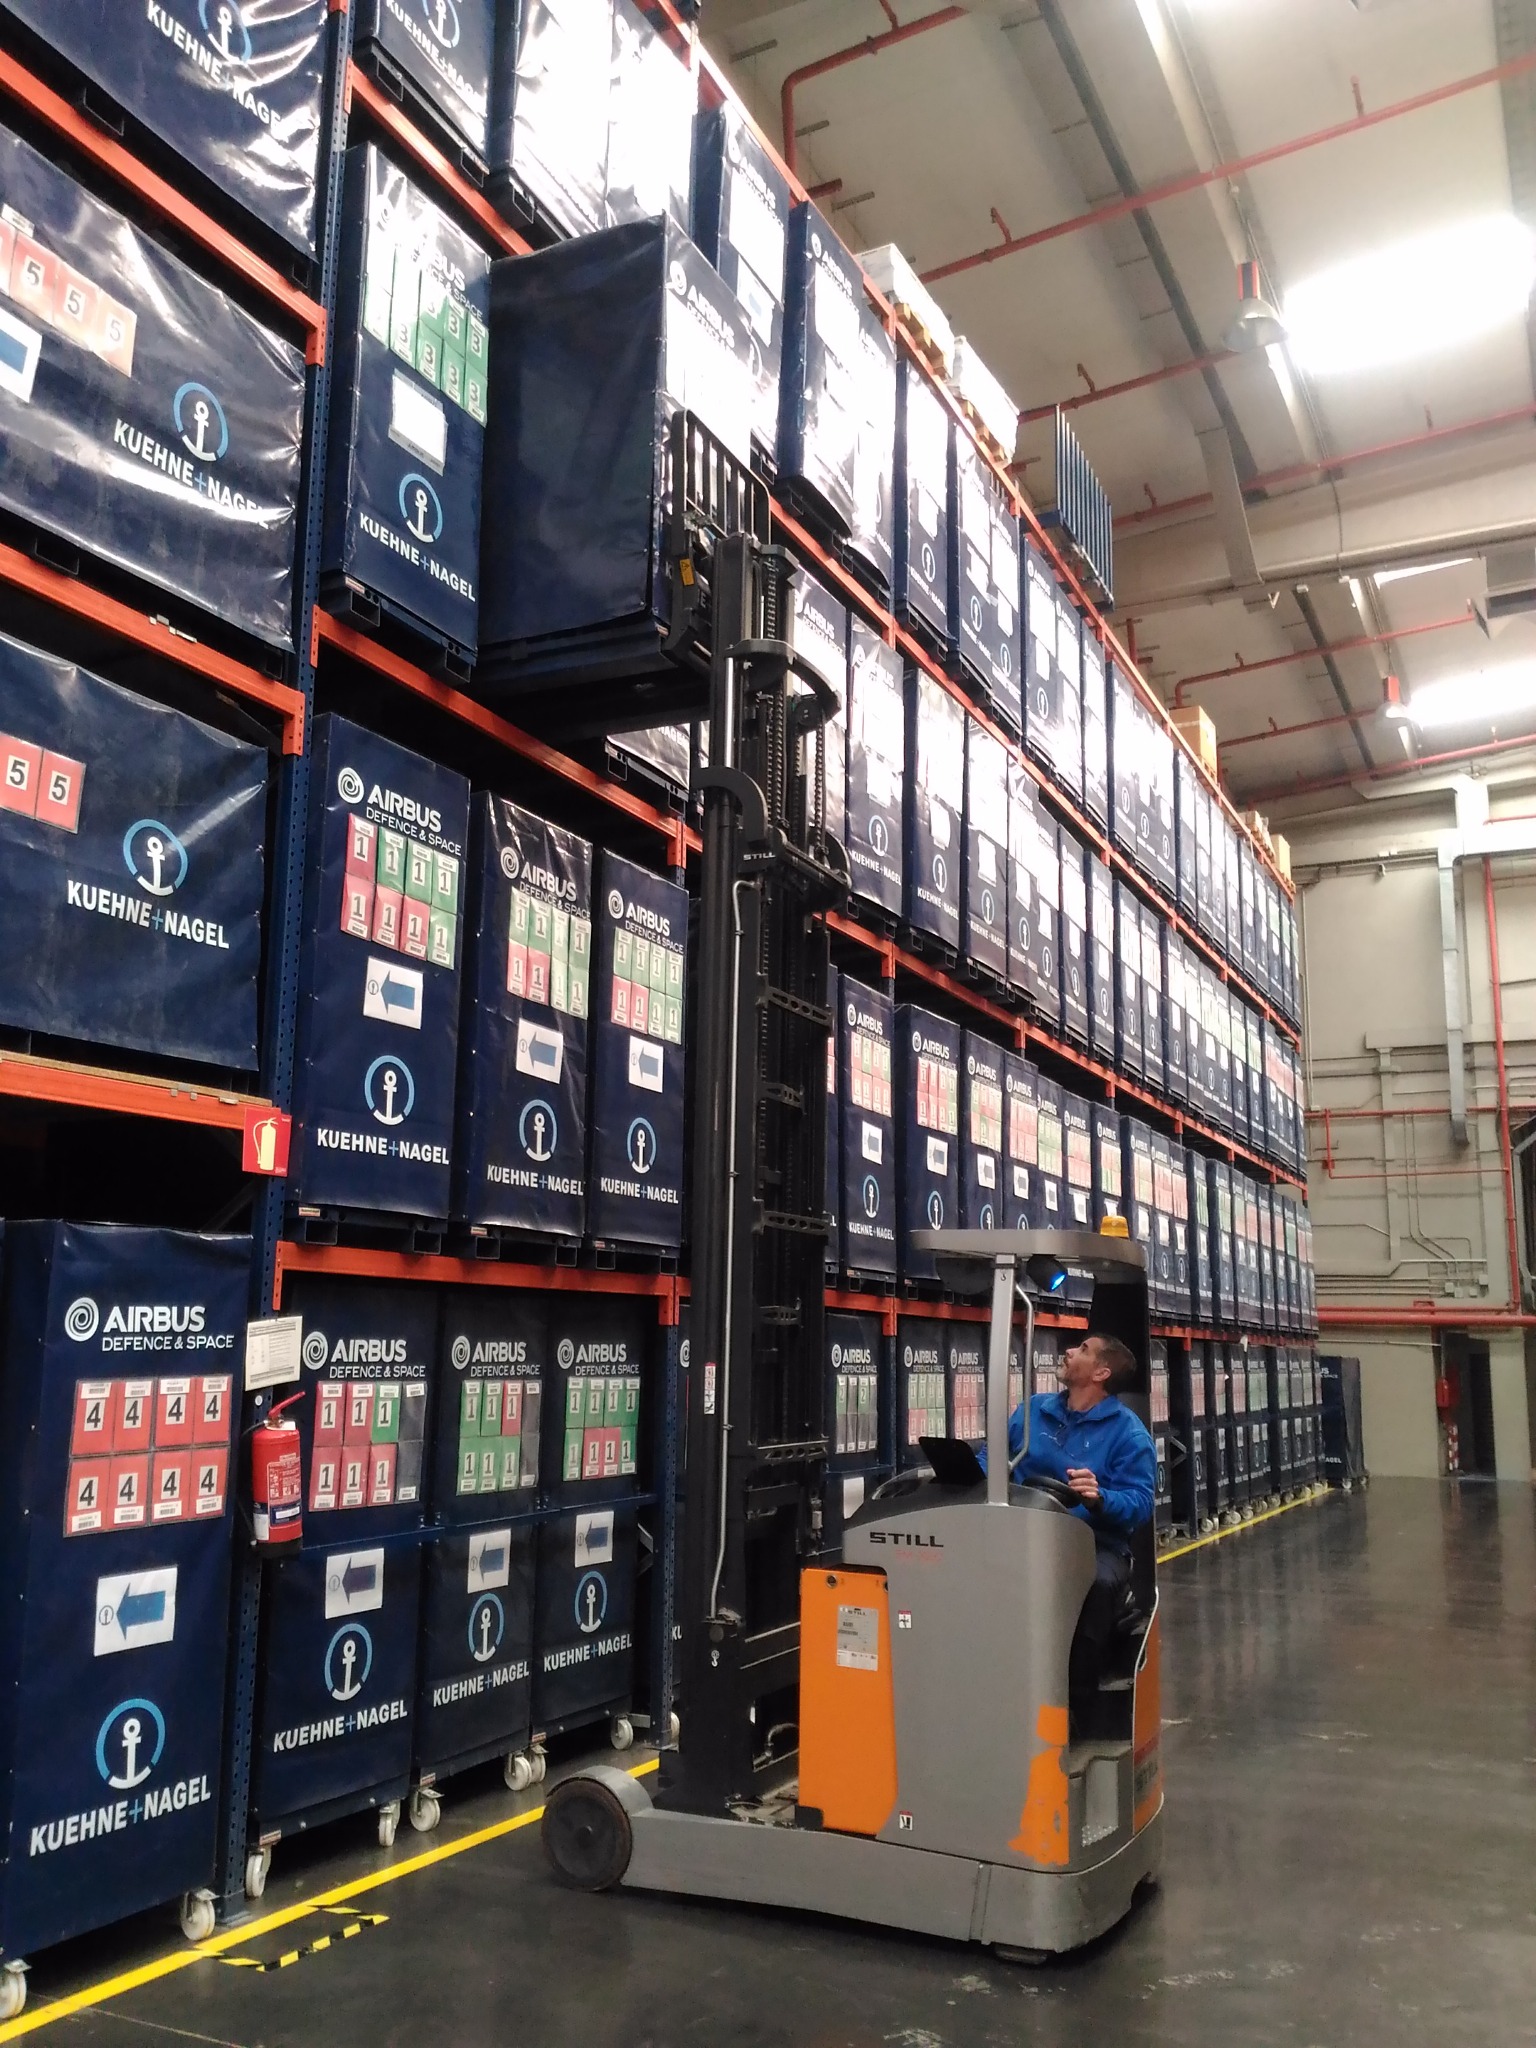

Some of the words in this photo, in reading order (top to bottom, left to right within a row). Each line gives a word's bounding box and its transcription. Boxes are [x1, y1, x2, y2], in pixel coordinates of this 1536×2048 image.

[26, 260, 42, 286] 5
[67, 289, 82, 315] 5
[110, 319, 122, 342] 5
[449, 315, 459, 336] 3
[472, 333, 481, 354] 3
[400, 323, 409, 345] 3
[424, 343, 434, 365] 3
[449, 364, 459, 385] 3
[469, 382, 480, 403] 3
[360, 511, 476, 603] KUEHNE+NAGEL
[9, 759, 27, 787] 5
[52, 775, 69, 802] 5
[367, 784, 442, 833] AIRBUS
[366, 806, 418, 840] DEFENCE
[418, 830, 427, 842] &
[428, 833, 462, 857] SPACE
[356, 836, 366, 859] 1
[387, 850, 396, 872] 1
[413, 861, 423, 884] 1
[439, 871, 449, 893] 1
[521, 861, 577, 902] AIRBUS
[67, 879, 230, 949] KUEHNE+NAGEL
[520, 881, 557, 909] DEFENCE
[565, 902, 591, 923] SPACE
[353, 896, 363, 918] 1
[383, 906, 393, 928] 1
[408, 916, 419, 938] 1
[436, 928, 446, 950] 1
[517, 909, 525, 927] 1
[537, 917, 545, 936] 1
[556, 926, 562, 944] 1
[576, 932, 583, 951] 1
[626, 902, 671, 937] AIRBUS
[625, 920, 657, 942] DEFENCE
[662, 937, 684, 955] SPACE
[857, 1012, 883, 1036] AIRBUS
[922, 1038, 950, 1060] AIRBUS
[317, 1127, 450, 1166] KUEHNE+NAGEL
[487, 1164, 584, 1198] KUEHNE+NAGEL
[600, 1177, 680, 1205] KUEHNE+NAGEL
[848, 1221, 895, 1240] KUEHNE+NAGEL
[103, 1305, 206, 1334] AIRBUS
[102, 1336, 172, 1352] DEFENCE
[174, 1335, 185, 1350] &
[186, 1334, 235, 1350] SPACE
[331, 1339, 407, 1363] AIRBUS
[472, 1342, 527, 1363] AIRBUS
[576, 1344, 627, 1363] AIRBUS
[842, 1349, 871, 1364] AIRBUS
[913, 1350, 938, 1364] AIRBUS
[329, 1366, 382, 1379] DEFENCE
[382, 1366, 392, 1378] &
[393, 1365, 426, 1378] SPACE
[471, 1365, 508, 1377] DEFENCE
[516, 1364, 541, 1375] SPACE
[575, 1365, 610, 1376] DEFENCE
[617, 1364, 640, 1375] SPACE
[86, 1401, 101, 1430] 4
[125, 1400, 140, 1426] 4
[168, 1395, 183, 1423] 4
[206, 1394, 219, 1420] 4
[323, 1402, 334, 1426] 1
[354, 1401, 364, 1425] 1
[380, 1402, 390, 1425] 1
[467, 1398, 475, 1419] 1
[487, 1397, 496, 1418] 1
[508, 1396, 516, 1418] 1
[571, 1393, 578, 1411] 1
[591, 1393, 599, 1412] 1
[610, 1392, 617, 1410] 1
[627, 1391, 634, 1410] 1
[465, 1454, 473, 1475] 1
[484, 1453, 493, 1475] 1
[505, 1452, 513, 1473] 1
[570, 1446, 577, 1466] 1
[591, 1444, 599, 1461] 1
[606, 1442, 614, 1460] 1
[623, 1442, 630, 1459] 1
[79, 1479, 95, 1507] 4
[119, 1475, 135, 1502] 4
[163, 1470, 178, 1498] 4
[200, 1467, 215, 1494] 4
[321, 1466, 331, 1489] 1
[349, 1465, 359, 1488] 1
[377, 1462, 387, 1485] 1
[870, 1532, 944, 1548] STILL
[543, 1633, 633, 1673] KUEHNE+NAGEL
[433, 1660, 530, 1709] KUEHNE+NAGEL
[273, 1700, 408, 1753] KUEHNE+NAGEL
[29, 1774, 211, 1857] KUEHNE+NAGEL
